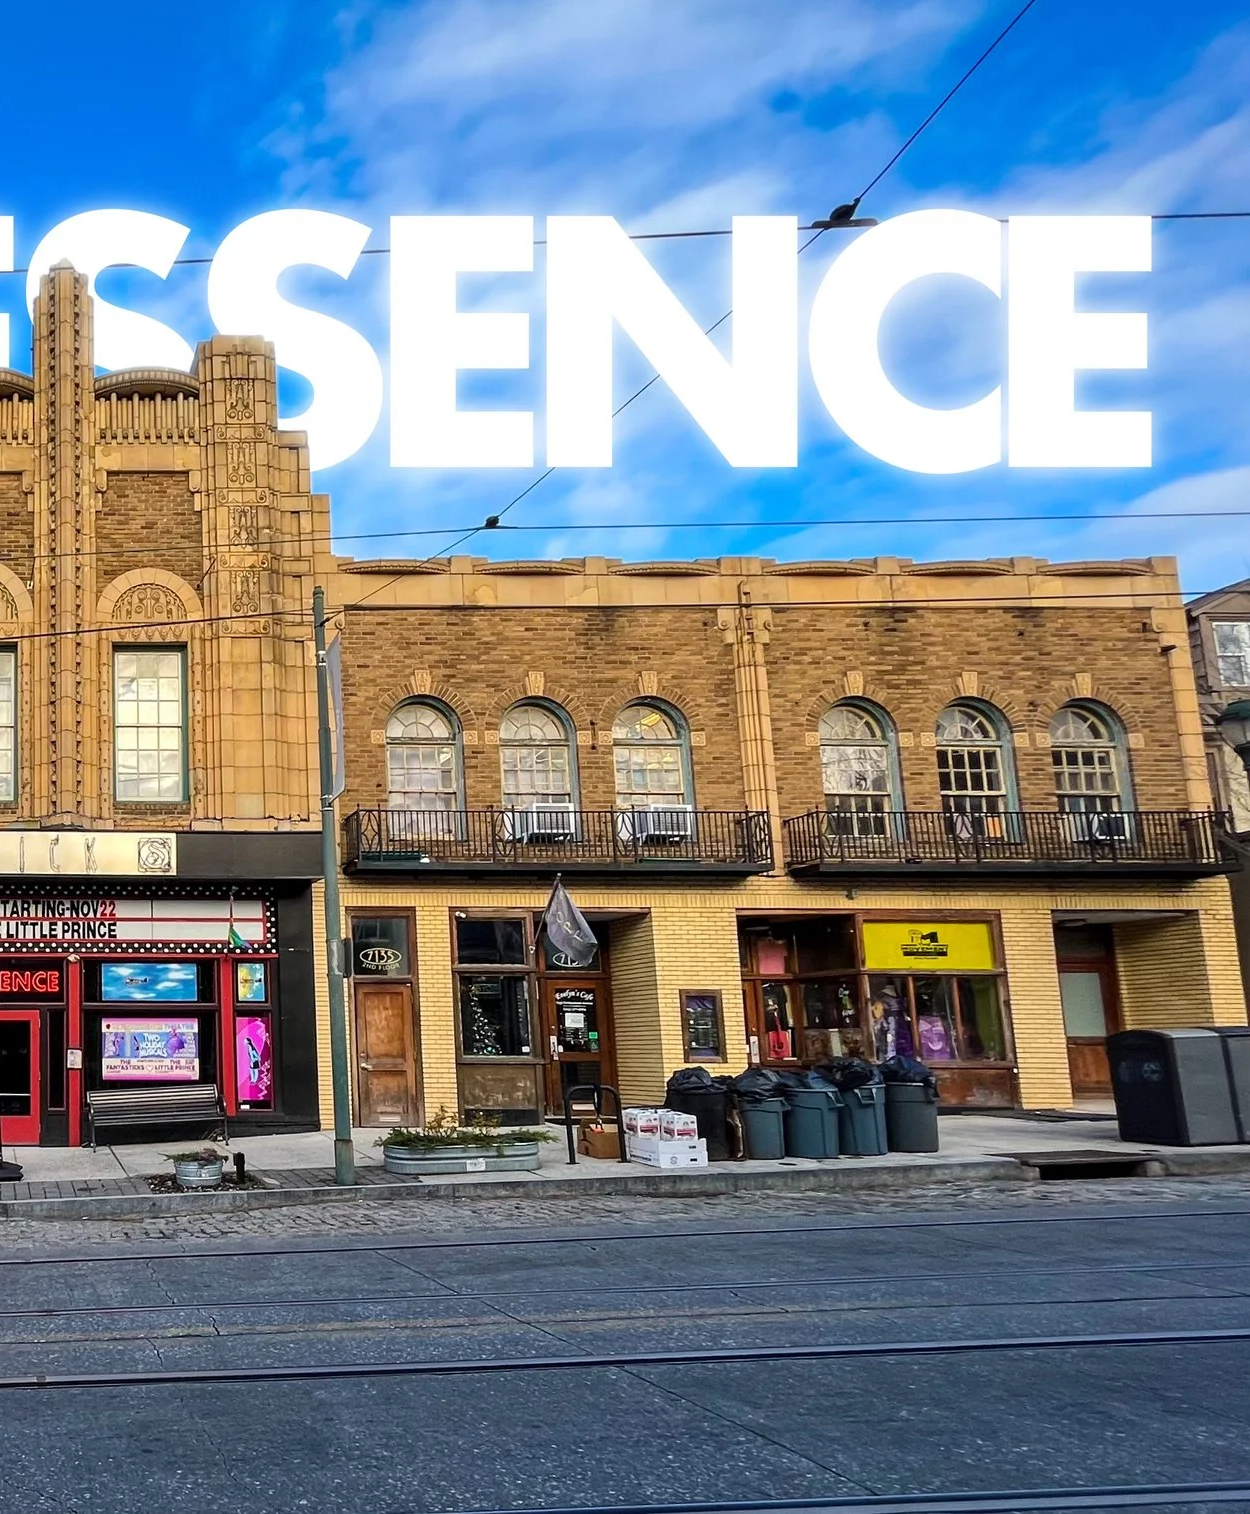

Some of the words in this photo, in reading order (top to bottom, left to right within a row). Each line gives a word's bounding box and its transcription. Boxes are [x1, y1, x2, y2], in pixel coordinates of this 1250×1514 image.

[6, 921, 58, 938] LITTLE
[62, 921, 117, 939] PRINCE
[367, 950, 395, 963] 7135
[143, 1032, 160, 1042] TWO
